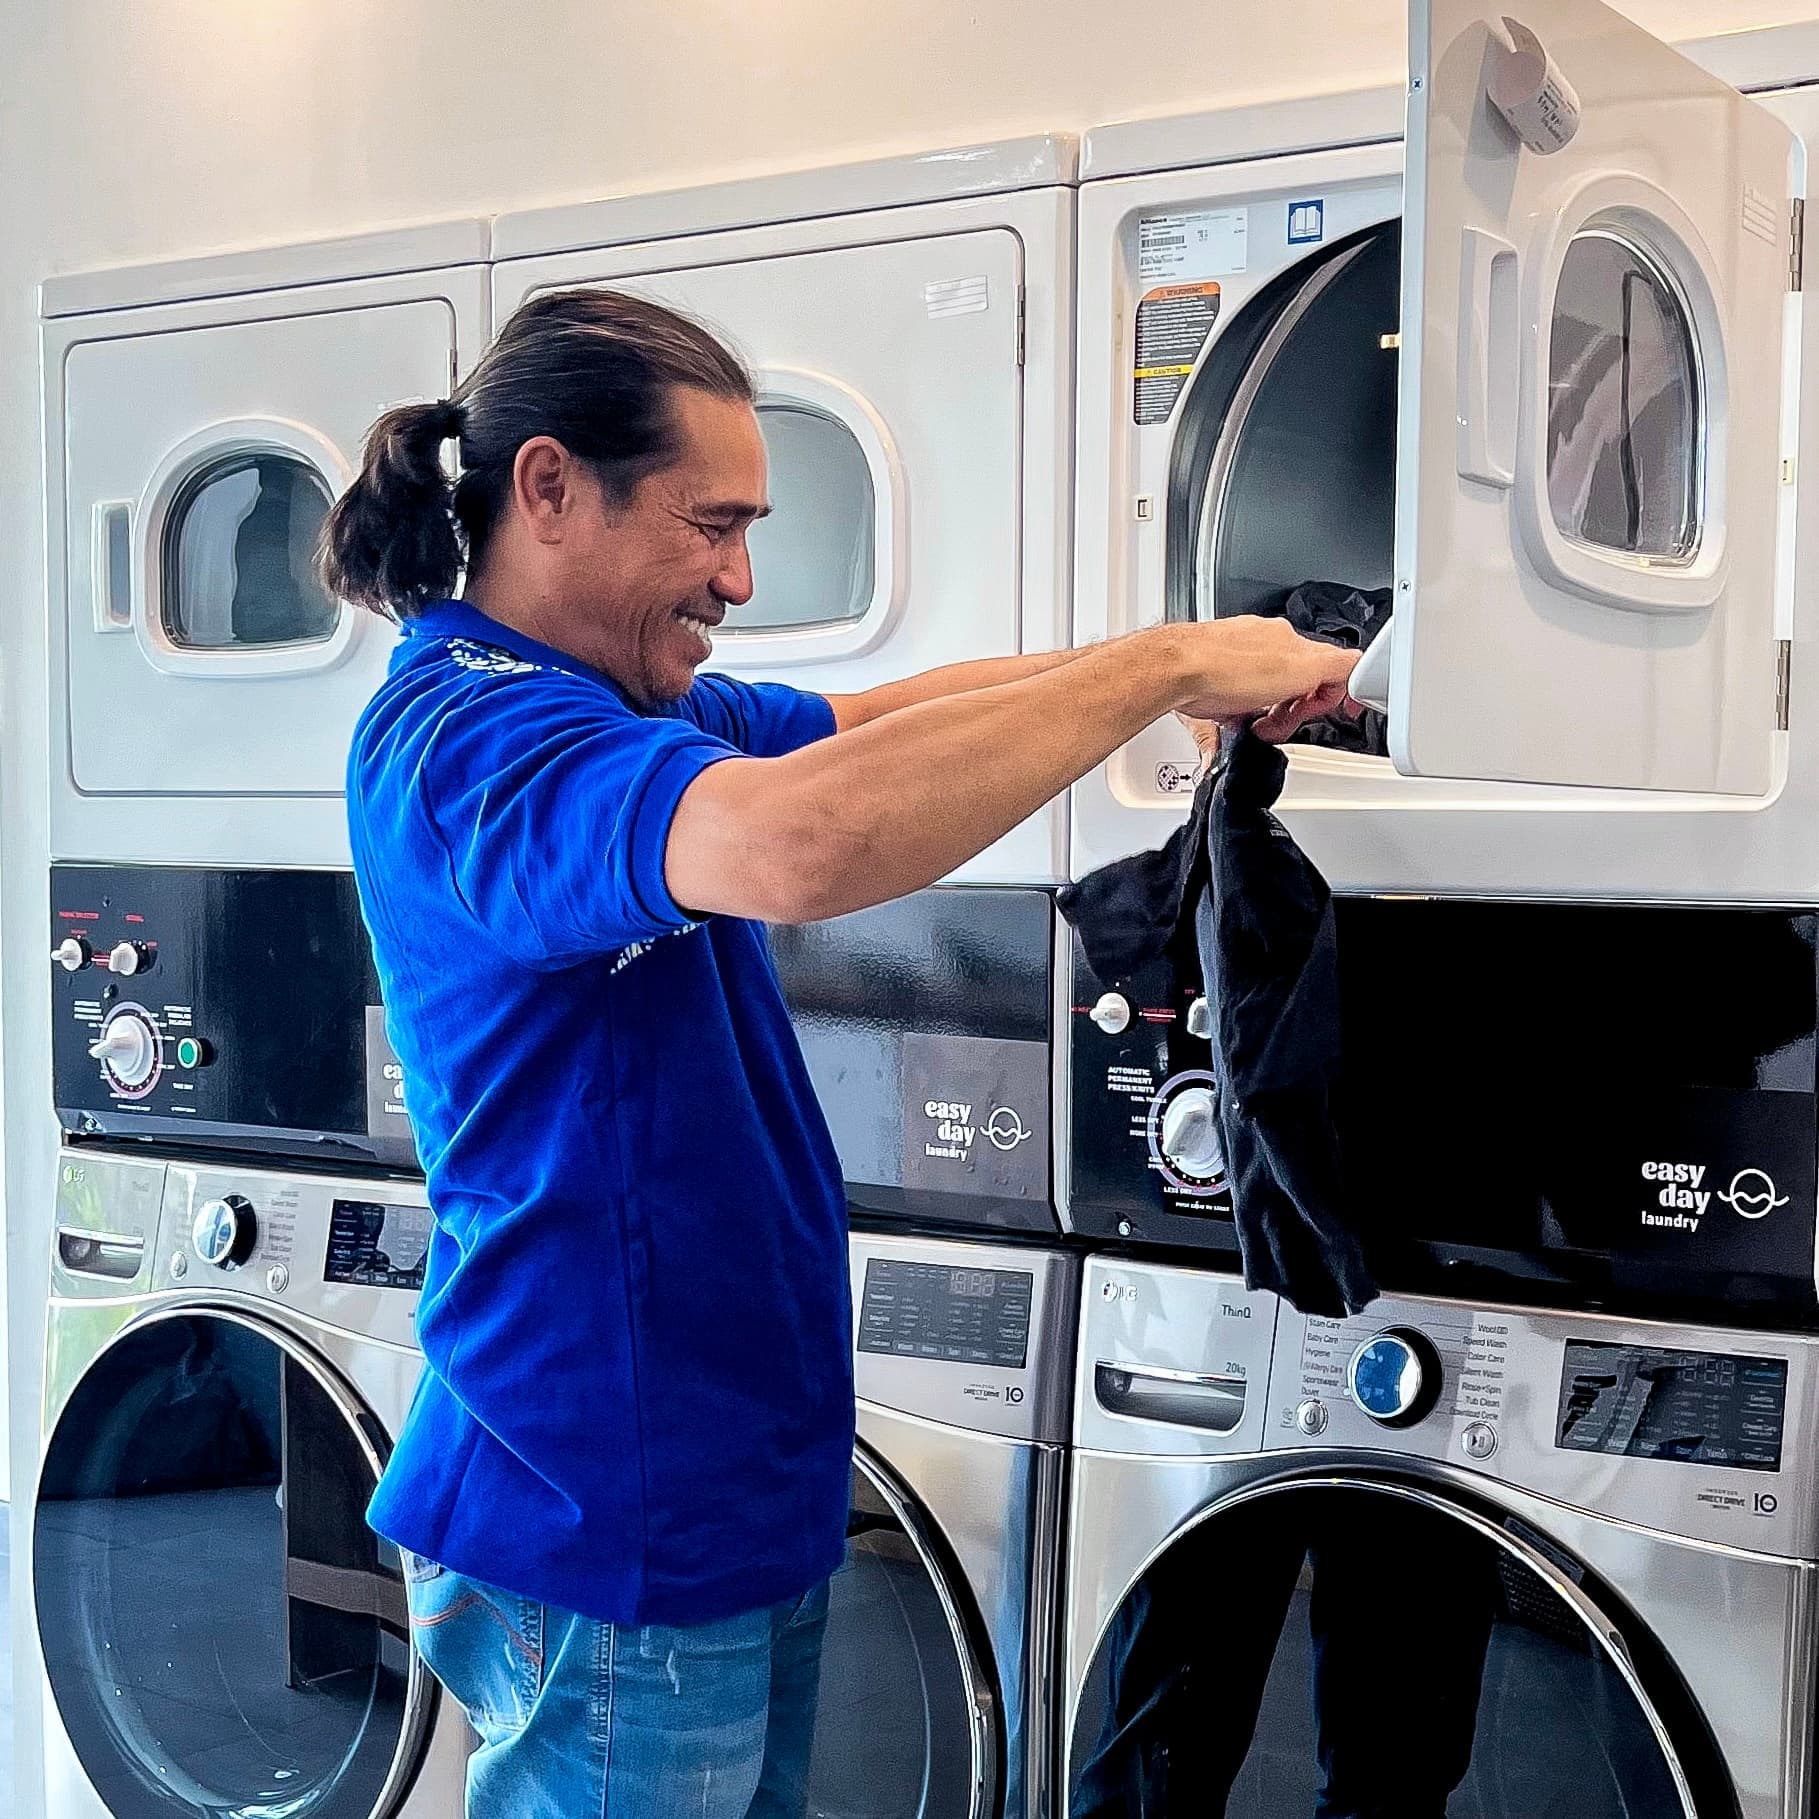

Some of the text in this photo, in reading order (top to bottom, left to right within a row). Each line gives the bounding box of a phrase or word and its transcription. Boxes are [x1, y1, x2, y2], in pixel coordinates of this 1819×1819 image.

[1107, 1066, 1151, 1076] AUTOMATIC
[924, 1100, 972, 1125] easy
[937, 1119, 976, 1147] day
[925, 1142, 968, 1162] laundry
[1641, 1161, 1706, 1189] easy
[1659, 1183, 1711, 1215] day
[1641, 1211, 1698, 1233] laundry
[1222, 1304, 1252, 1318] ThinQ
[1225, 1361, 1246, 1377] 20kg
